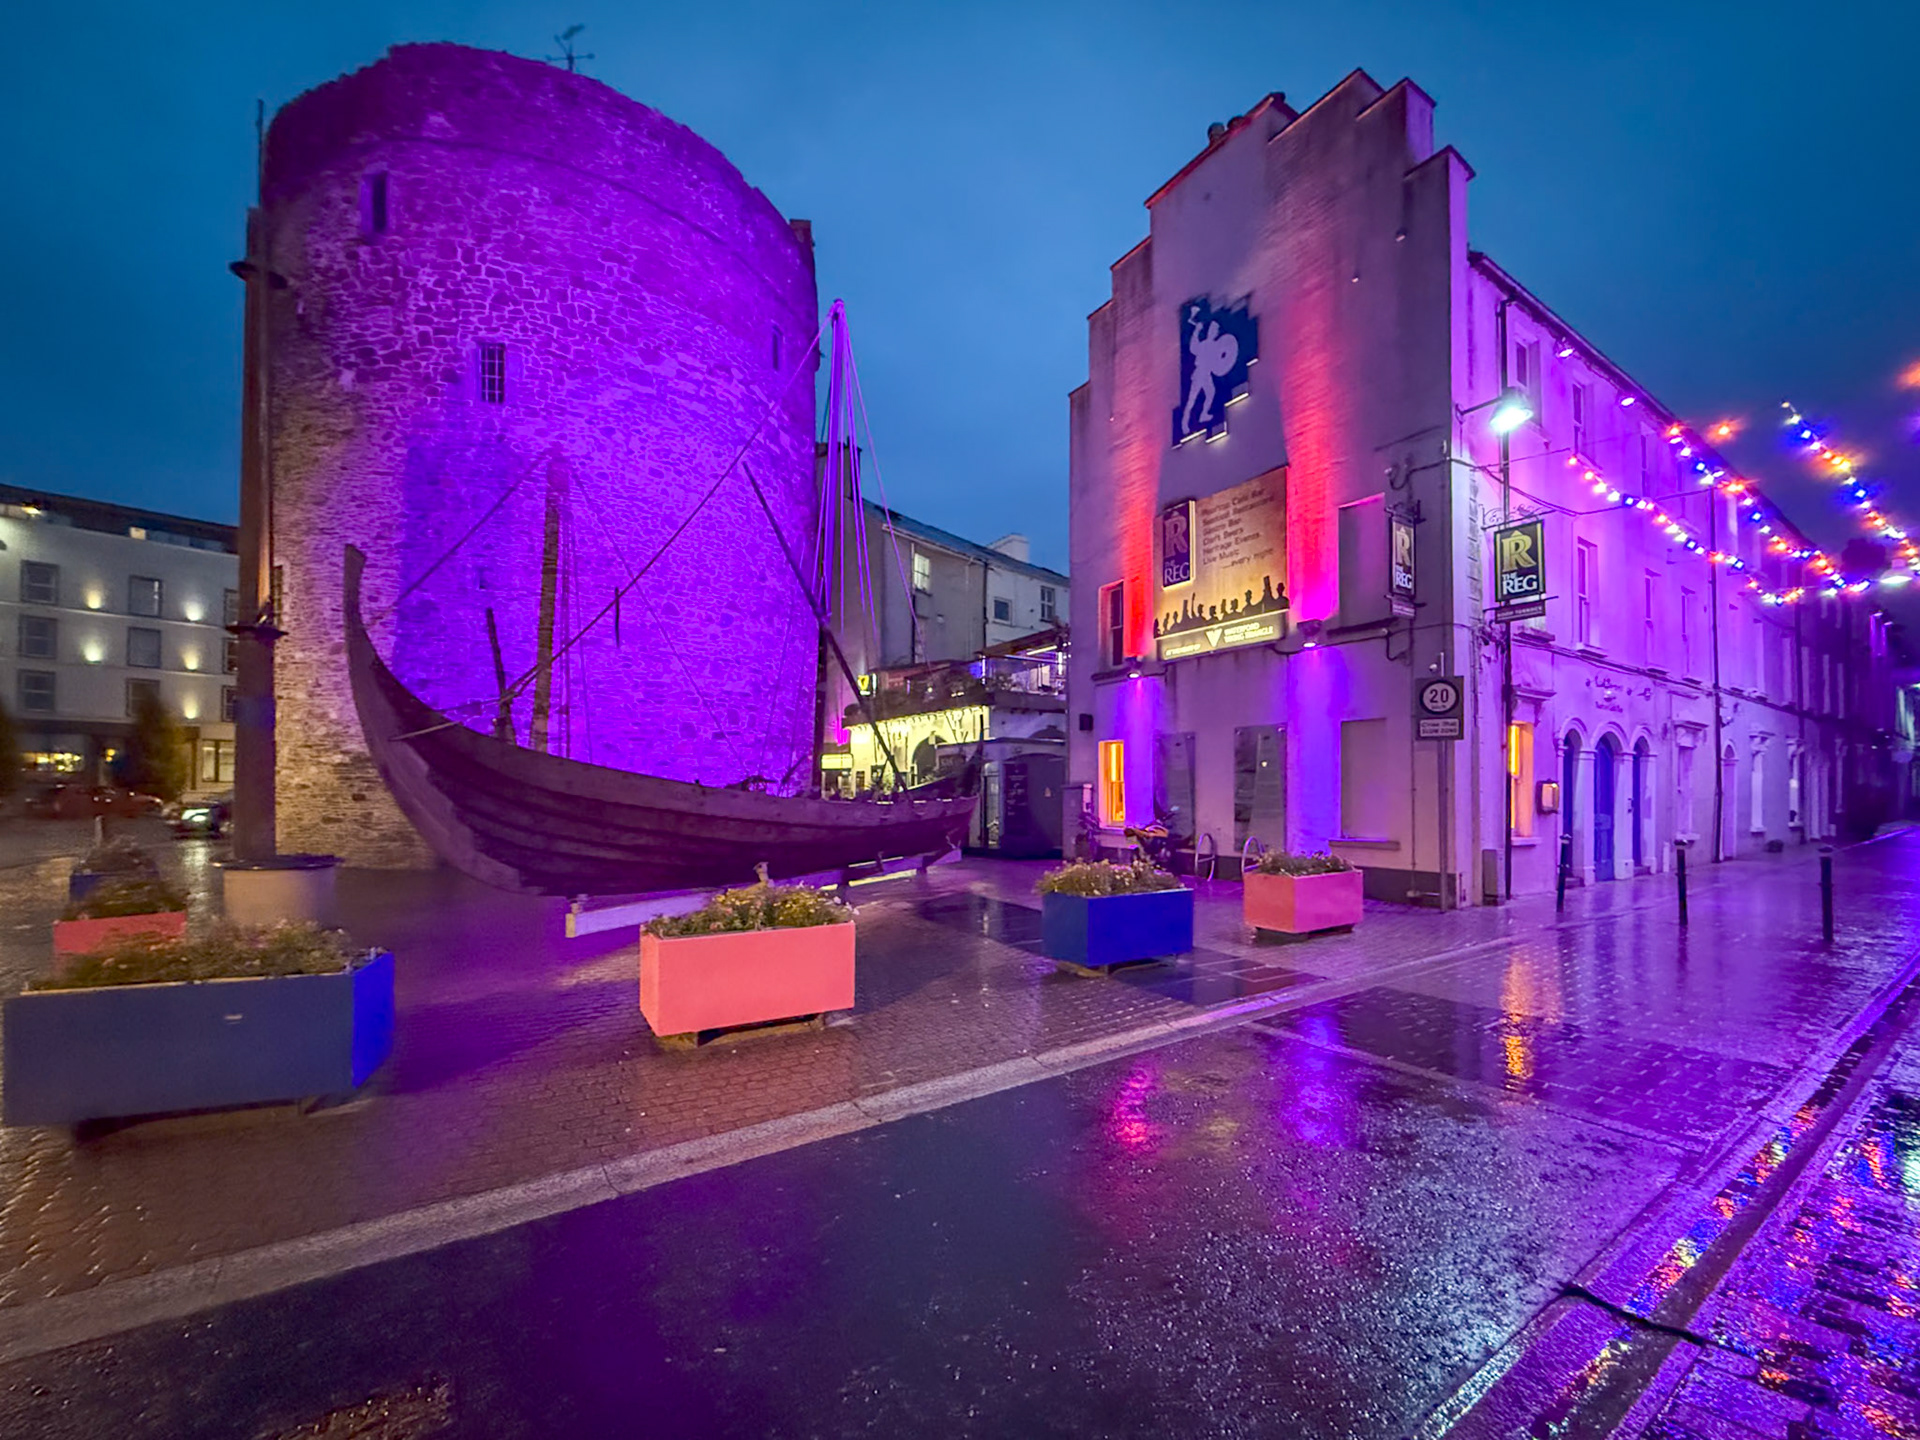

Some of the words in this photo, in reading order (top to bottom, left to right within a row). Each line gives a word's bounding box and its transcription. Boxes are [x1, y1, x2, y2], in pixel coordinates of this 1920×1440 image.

[1397, 530, 1411, 567] R
[1501, 533, 1537, 573] R
[1203, 556, 1217, 565] Live
[1164, 562, 1190, 585] REG
[1396, 571, 1412, 589] REG
[1502, 571, 1518, 581] THE
[1502, 574, 1538, 595] REG
[1429, 688, 1449, 703] 20
